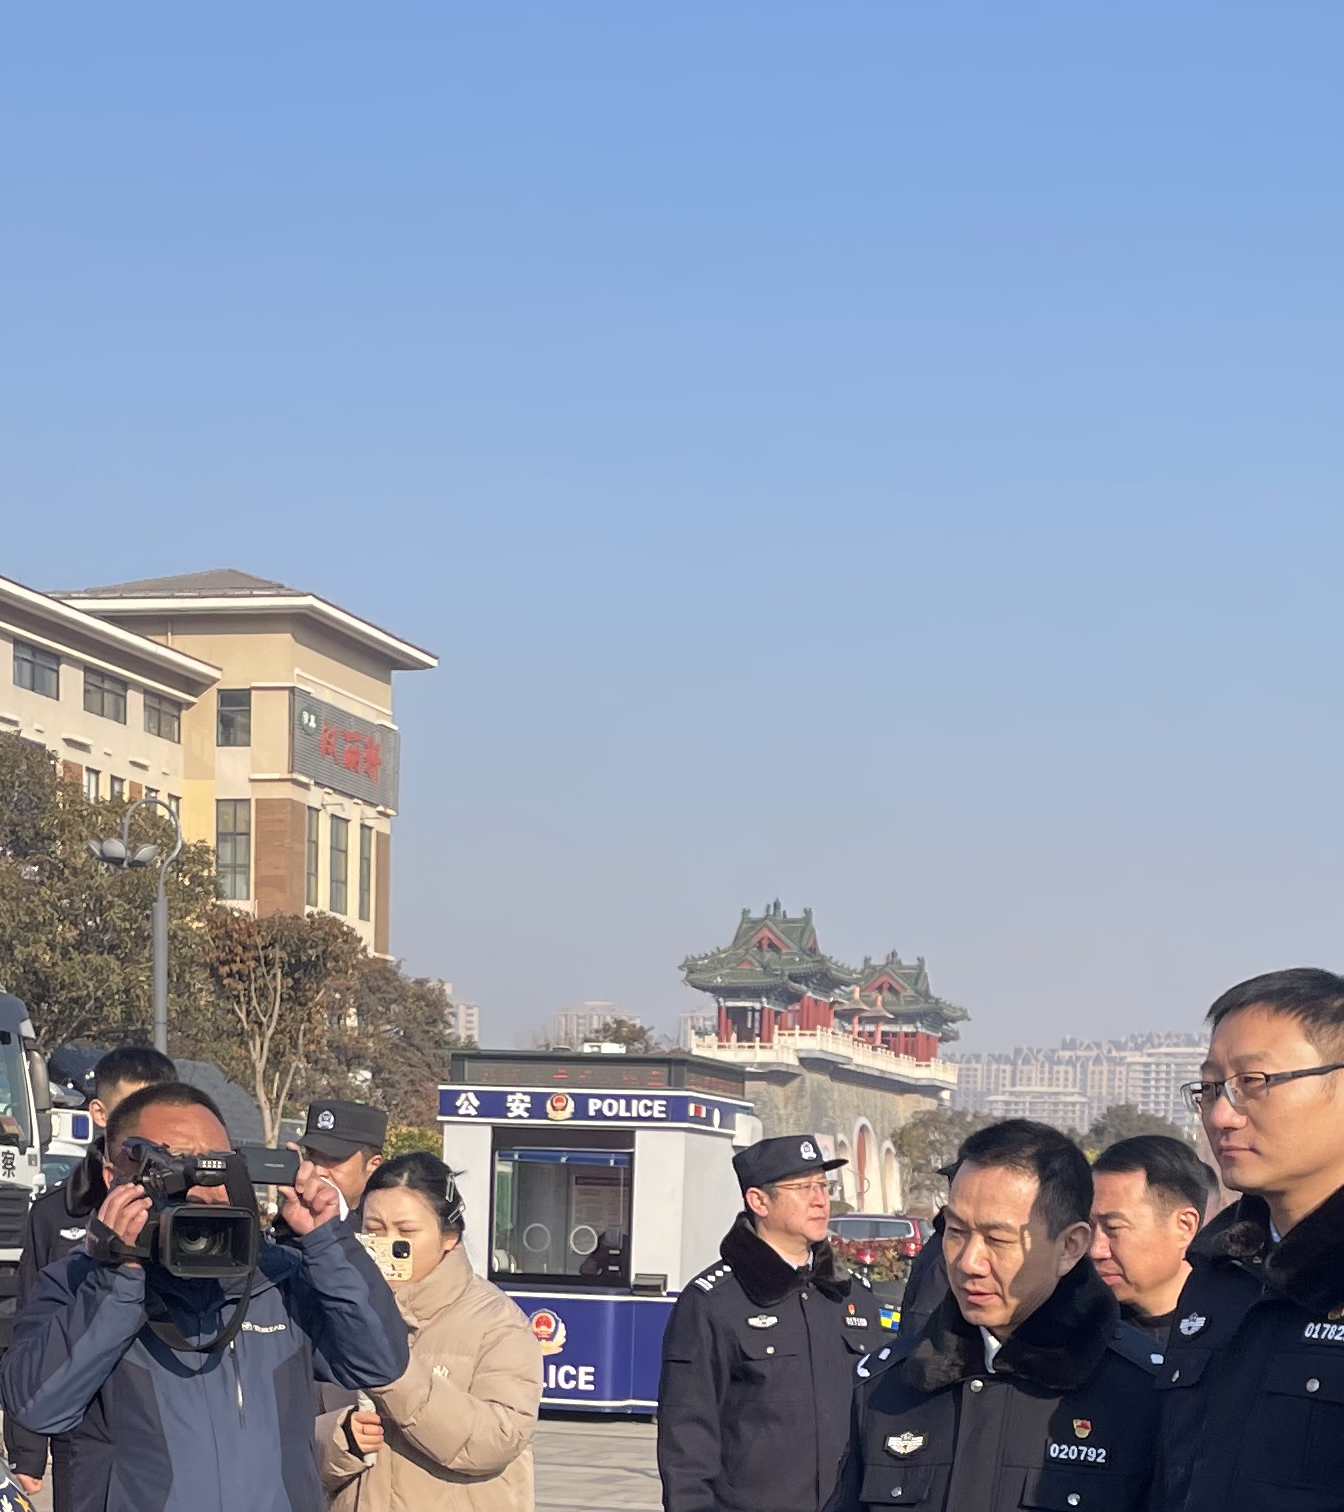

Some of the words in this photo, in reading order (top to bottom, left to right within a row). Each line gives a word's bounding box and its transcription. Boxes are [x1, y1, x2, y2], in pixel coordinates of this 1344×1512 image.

[455, 1092, 532, 1118] 公安
[588, 1097, 667, 1119] POLICE
[542, 1364, 595, 1391] ICE
[1049, 1443, 1107, 1463] 020792
